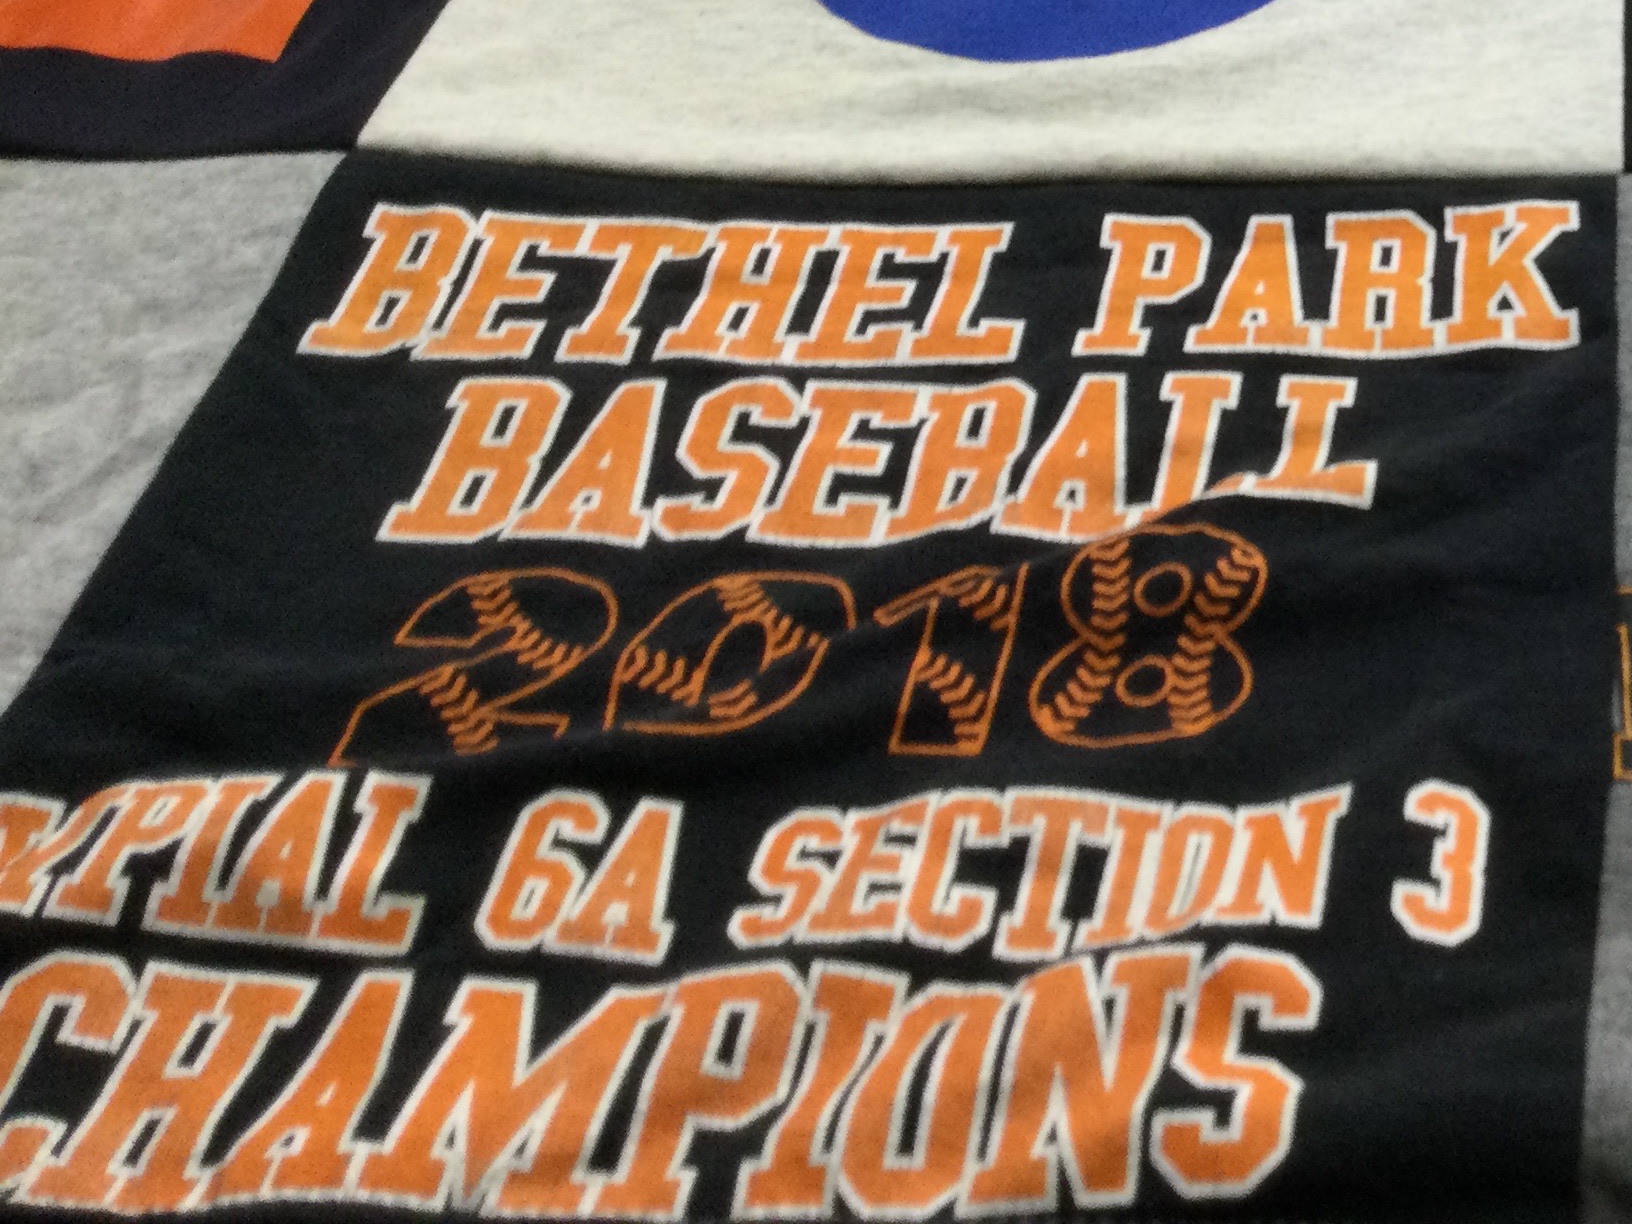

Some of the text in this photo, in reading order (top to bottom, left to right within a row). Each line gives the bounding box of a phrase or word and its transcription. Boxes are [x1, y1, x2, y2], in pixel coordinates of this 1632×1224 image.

[296, 200, 1583, 368] BETHEL PARK
[376, 372, 1378, 548] BASEBALL
[328, 523, 1271, 766] 2018
[474, 787, 684, 964] 6A
[727, 784, 1353, 962] SECTION
[1391, 778, 1491, 946] 3
[0, 942, 1322, 1224] CHAMPIONS
